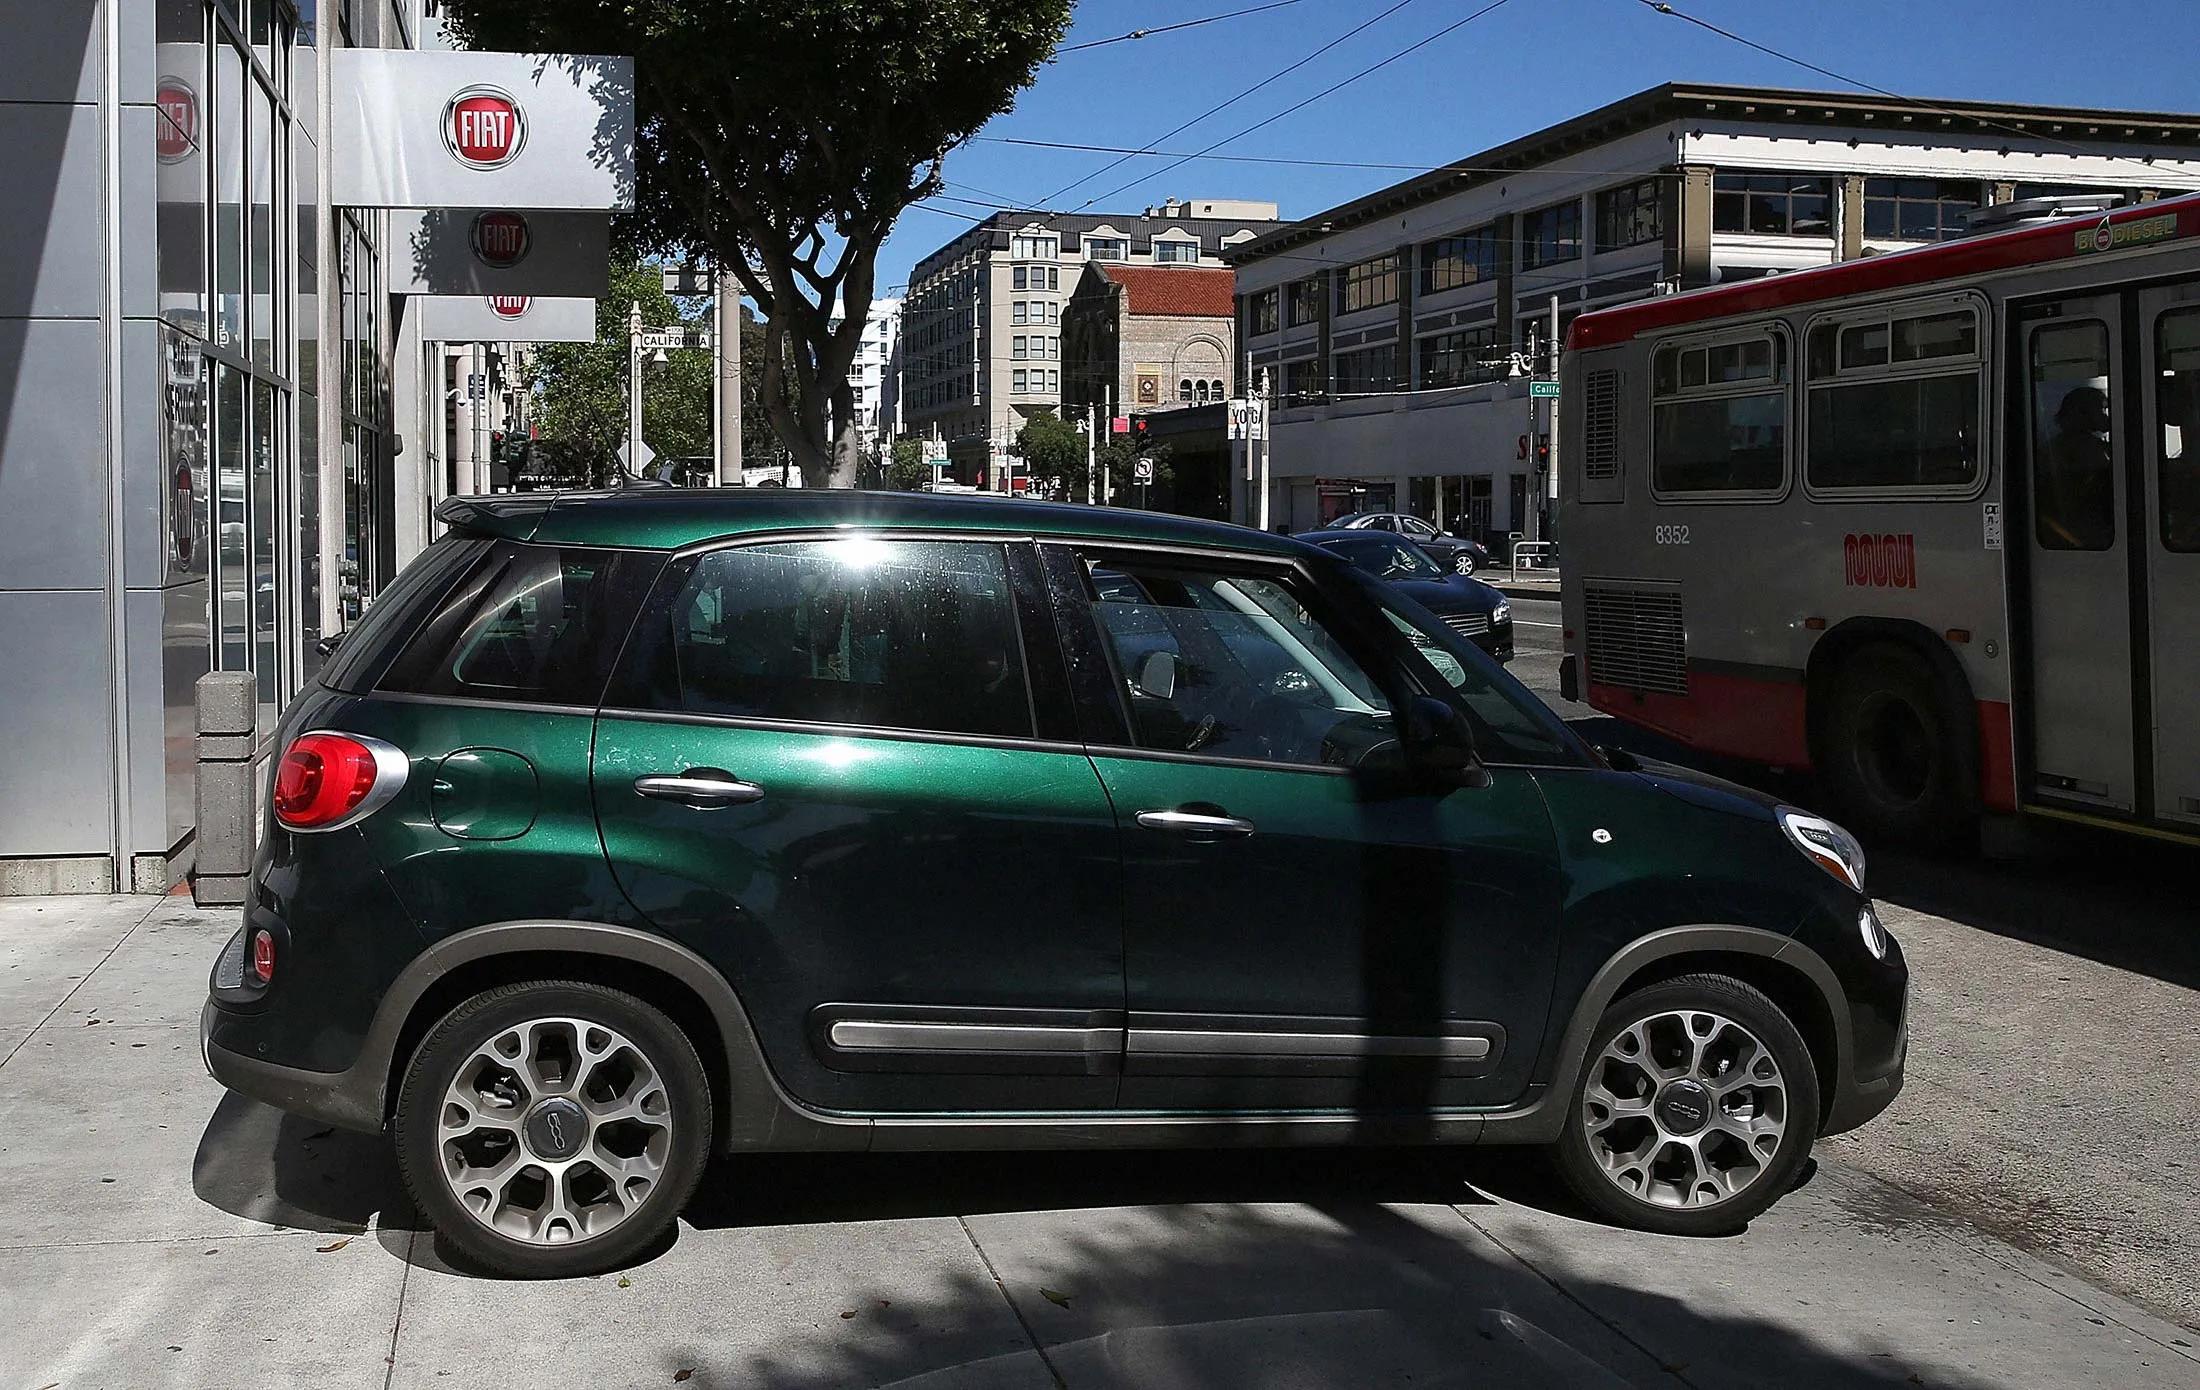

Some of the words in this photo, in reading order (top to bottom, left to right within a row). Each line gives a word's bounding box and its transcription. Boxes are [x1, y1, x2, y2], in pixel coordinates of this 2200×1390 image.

[461, 111, 509, 148] FIAT
[484, 224, 519, 252] FIAT
[643, 336, 707, 346] CALIFORNIA
[1655, 525, 1690, 545] 8352
